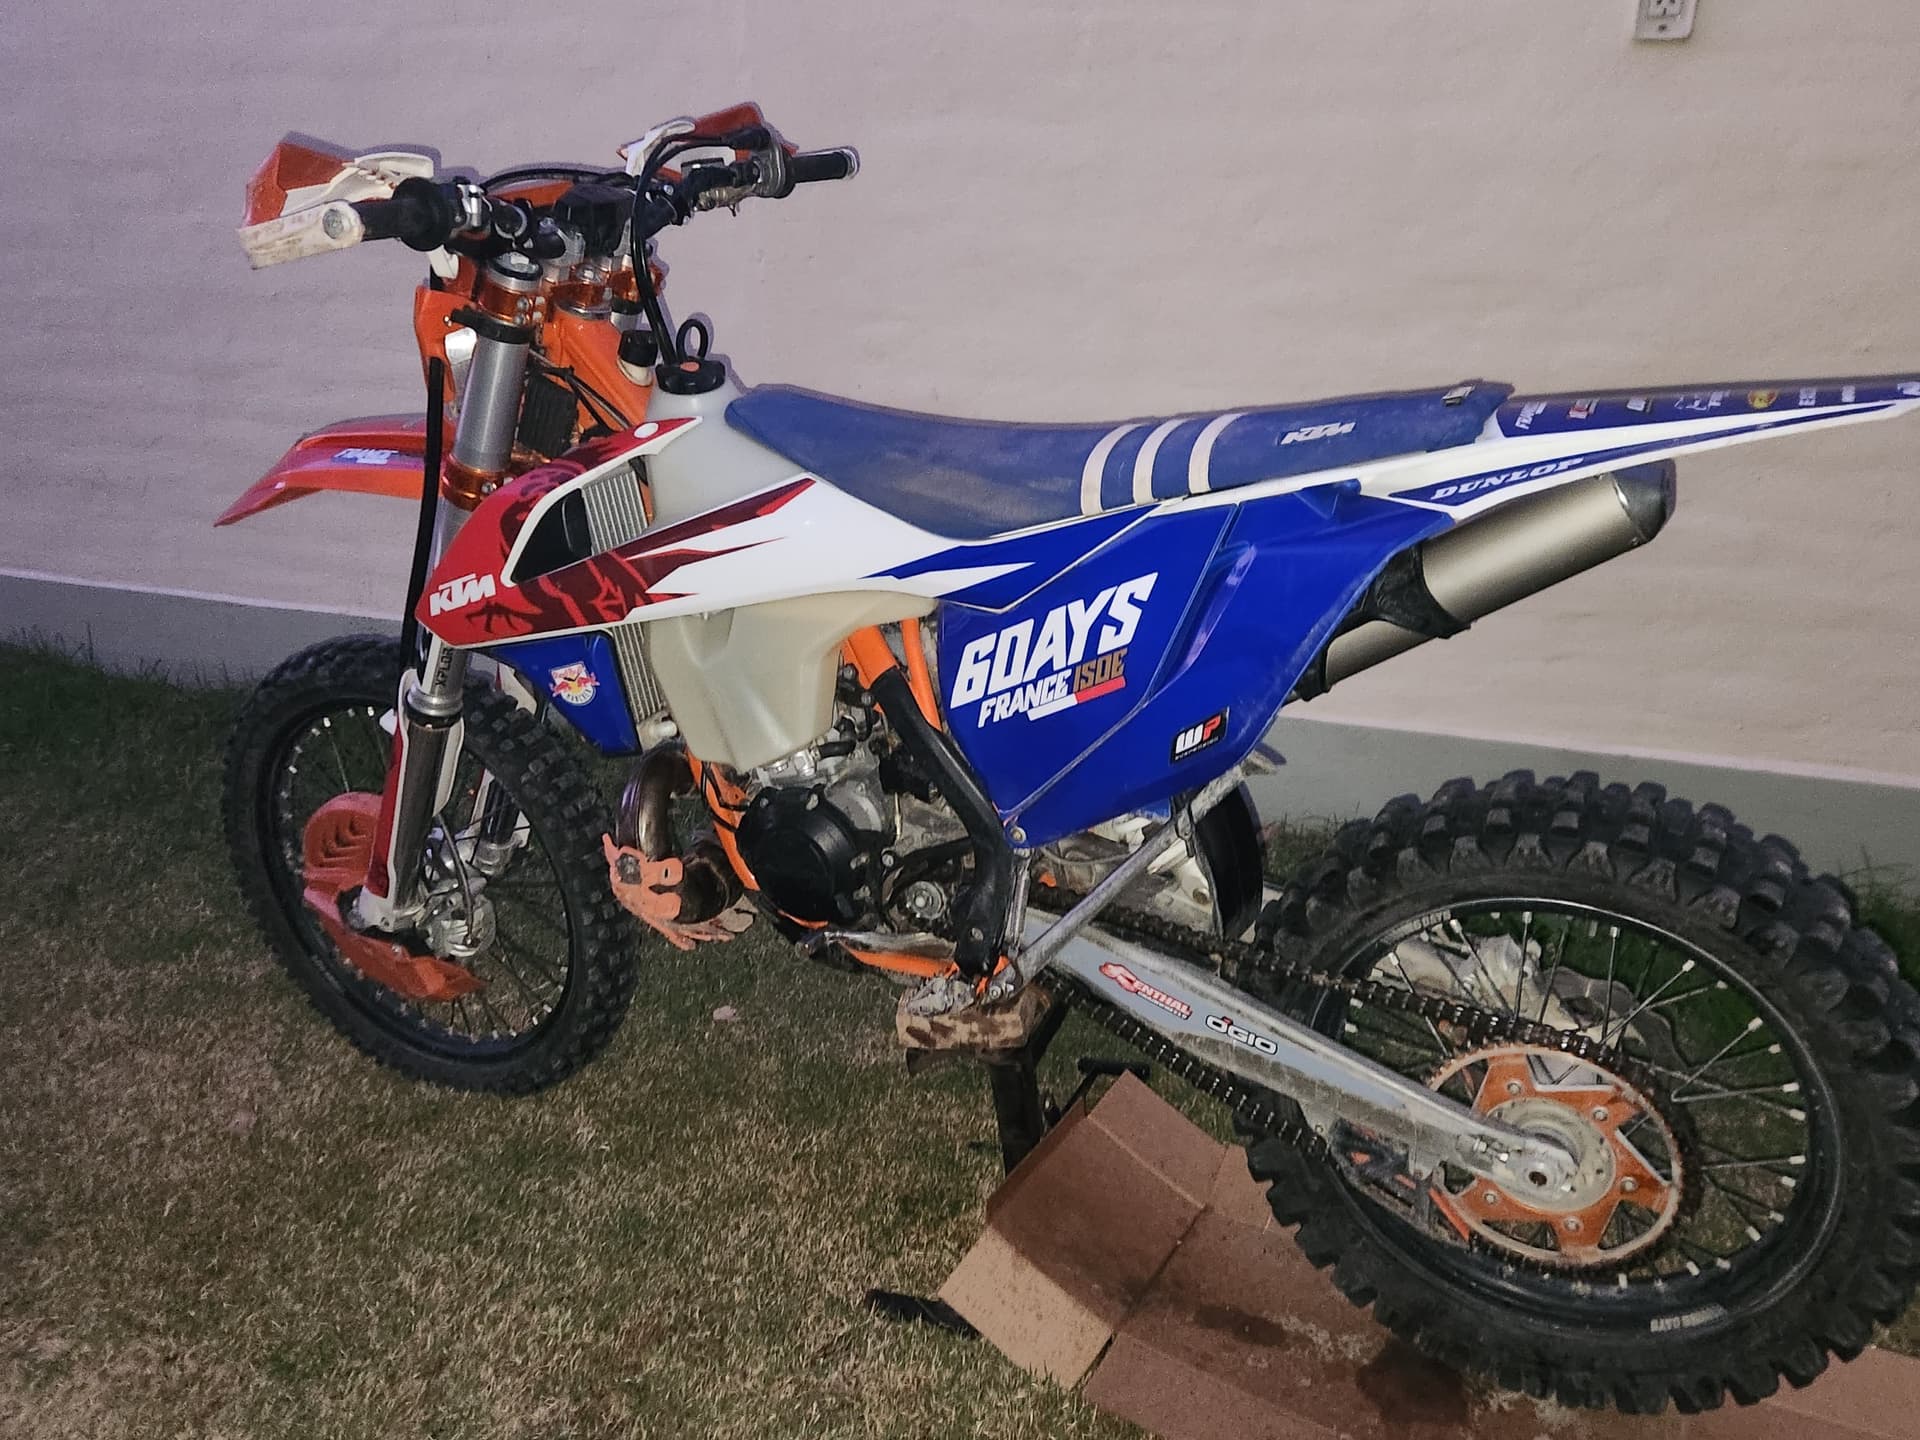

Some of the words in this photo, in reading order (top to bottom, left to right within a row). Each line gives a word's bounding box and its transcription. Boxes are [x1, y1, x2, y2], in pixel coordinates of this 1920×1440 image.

[1280, 422, 1356, 445] KTM
[1430, 456, 1585, 500] DUNLOP
[429, 573, 496, 617] KTM
[950, 572, 1158, 709] 6DAYS
[977, 668, 1073, 728] FRANCE
[1073, 648, 1128, 693] ISDE
[1175, 714, 1222, 754] WP
[1205, 1014, 1278, 1055] OGIO
